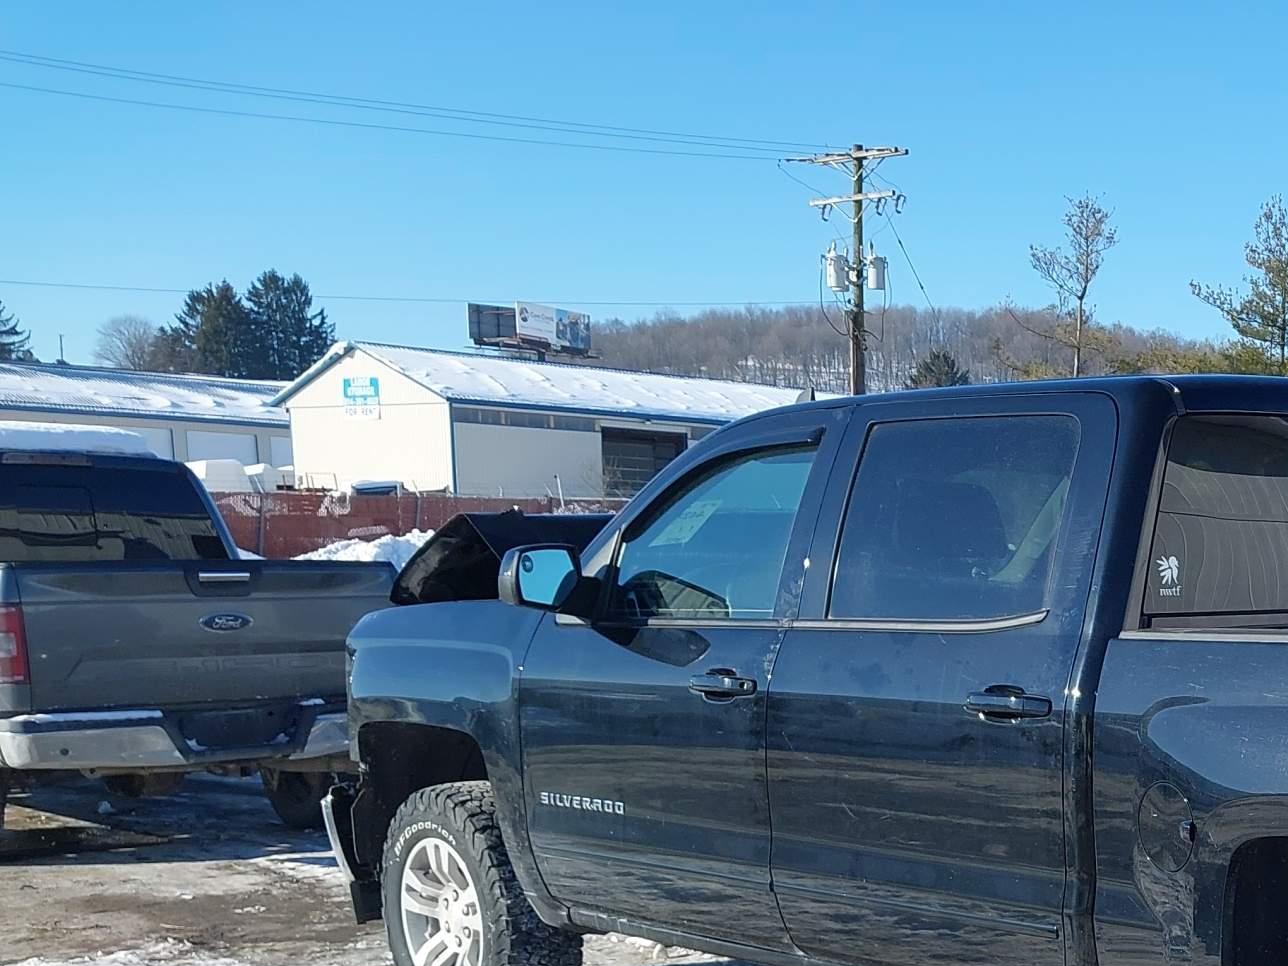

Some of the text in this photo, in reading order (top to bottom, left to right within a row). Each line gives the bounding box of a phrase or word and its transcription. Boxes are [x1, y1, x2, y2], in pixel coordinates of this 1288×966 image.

[212, 615, 242, 629] Ford
[538, 791, 626, 816] SILVERADO
[393, 820, 457, 857] BFGoodrich
